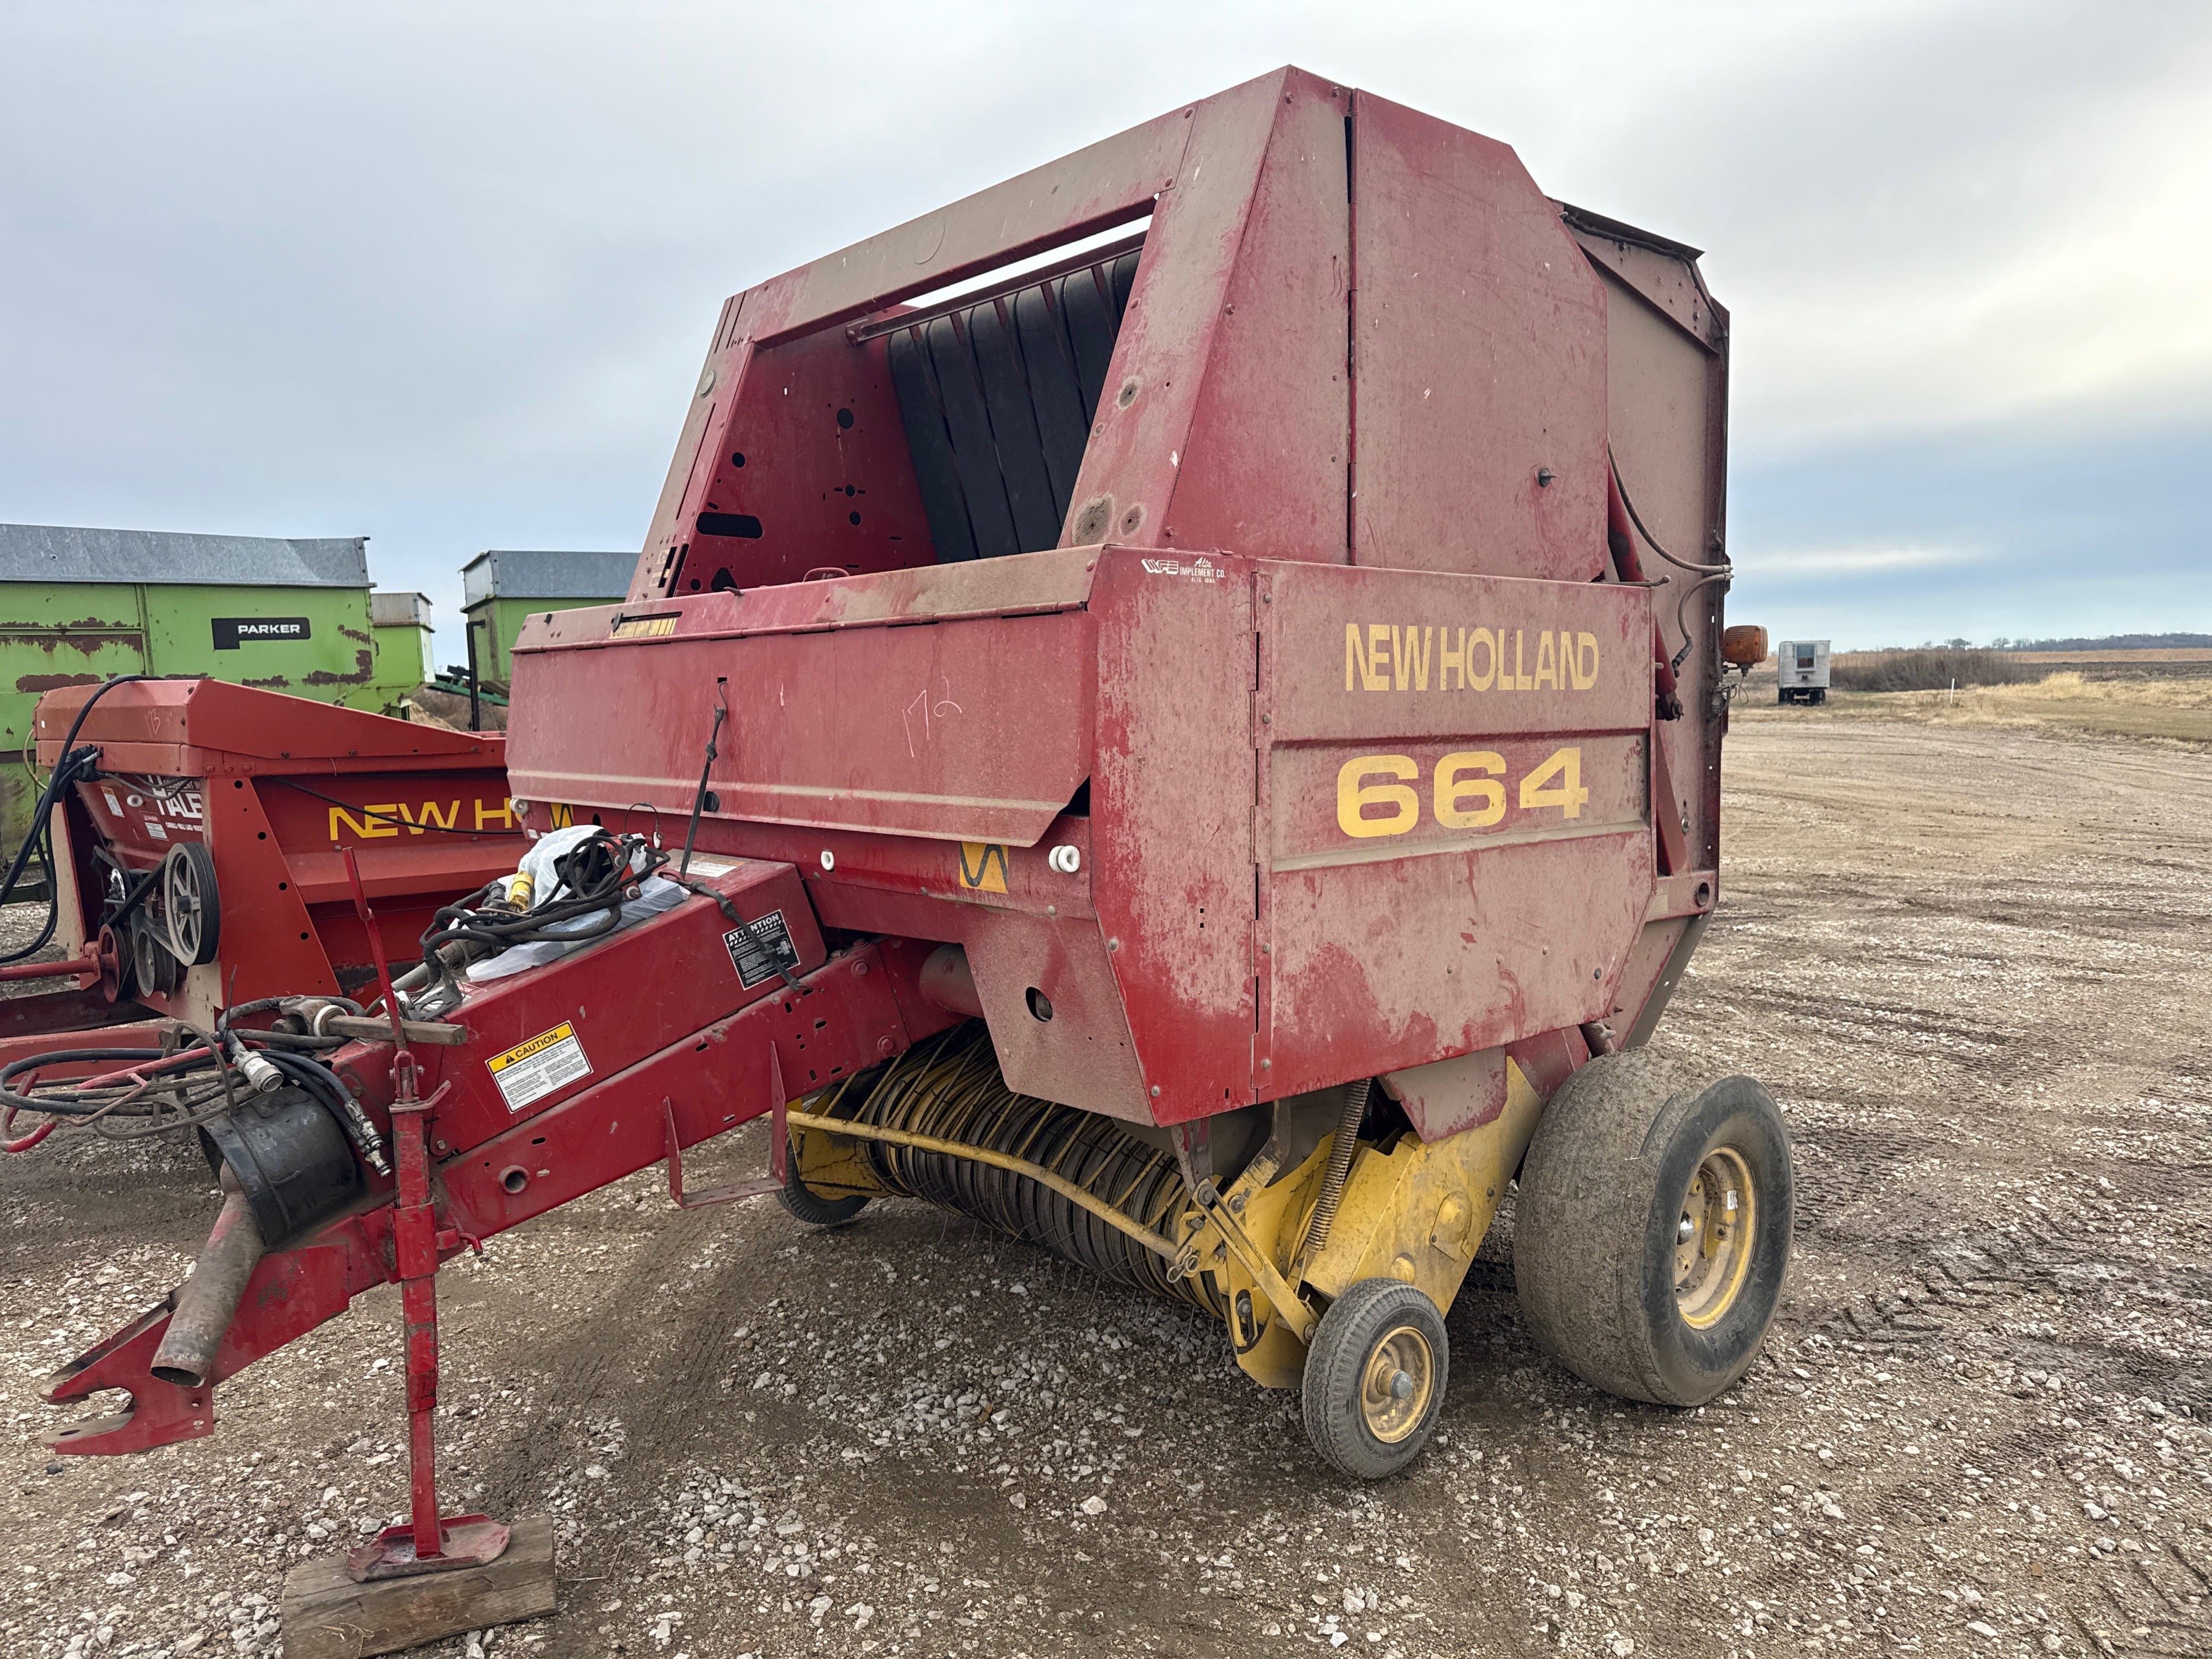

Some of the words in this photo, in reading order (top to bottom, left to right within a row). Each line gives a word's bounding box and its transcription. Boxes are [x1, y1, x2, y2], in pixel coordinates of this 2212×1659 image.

[1180, 566, 1214, 577] IMPLEMENT
[1217, 568, 1226, 578] CO.
[1194, 556, 1213, 568] Alta
[238, 624, 300, 634] PARKER
[1345, 623, 1433, 691] NEW
[1440, 627, 1599, 692] HOLLAND
[1337, 747, 1589, 838] 664
[329, 800, 460, 841] NEW
[474, 797, 522, 830] H
[729, 914, 779, 942] ATTNTION
[515, 1032, 559, 1057] CAUTION
